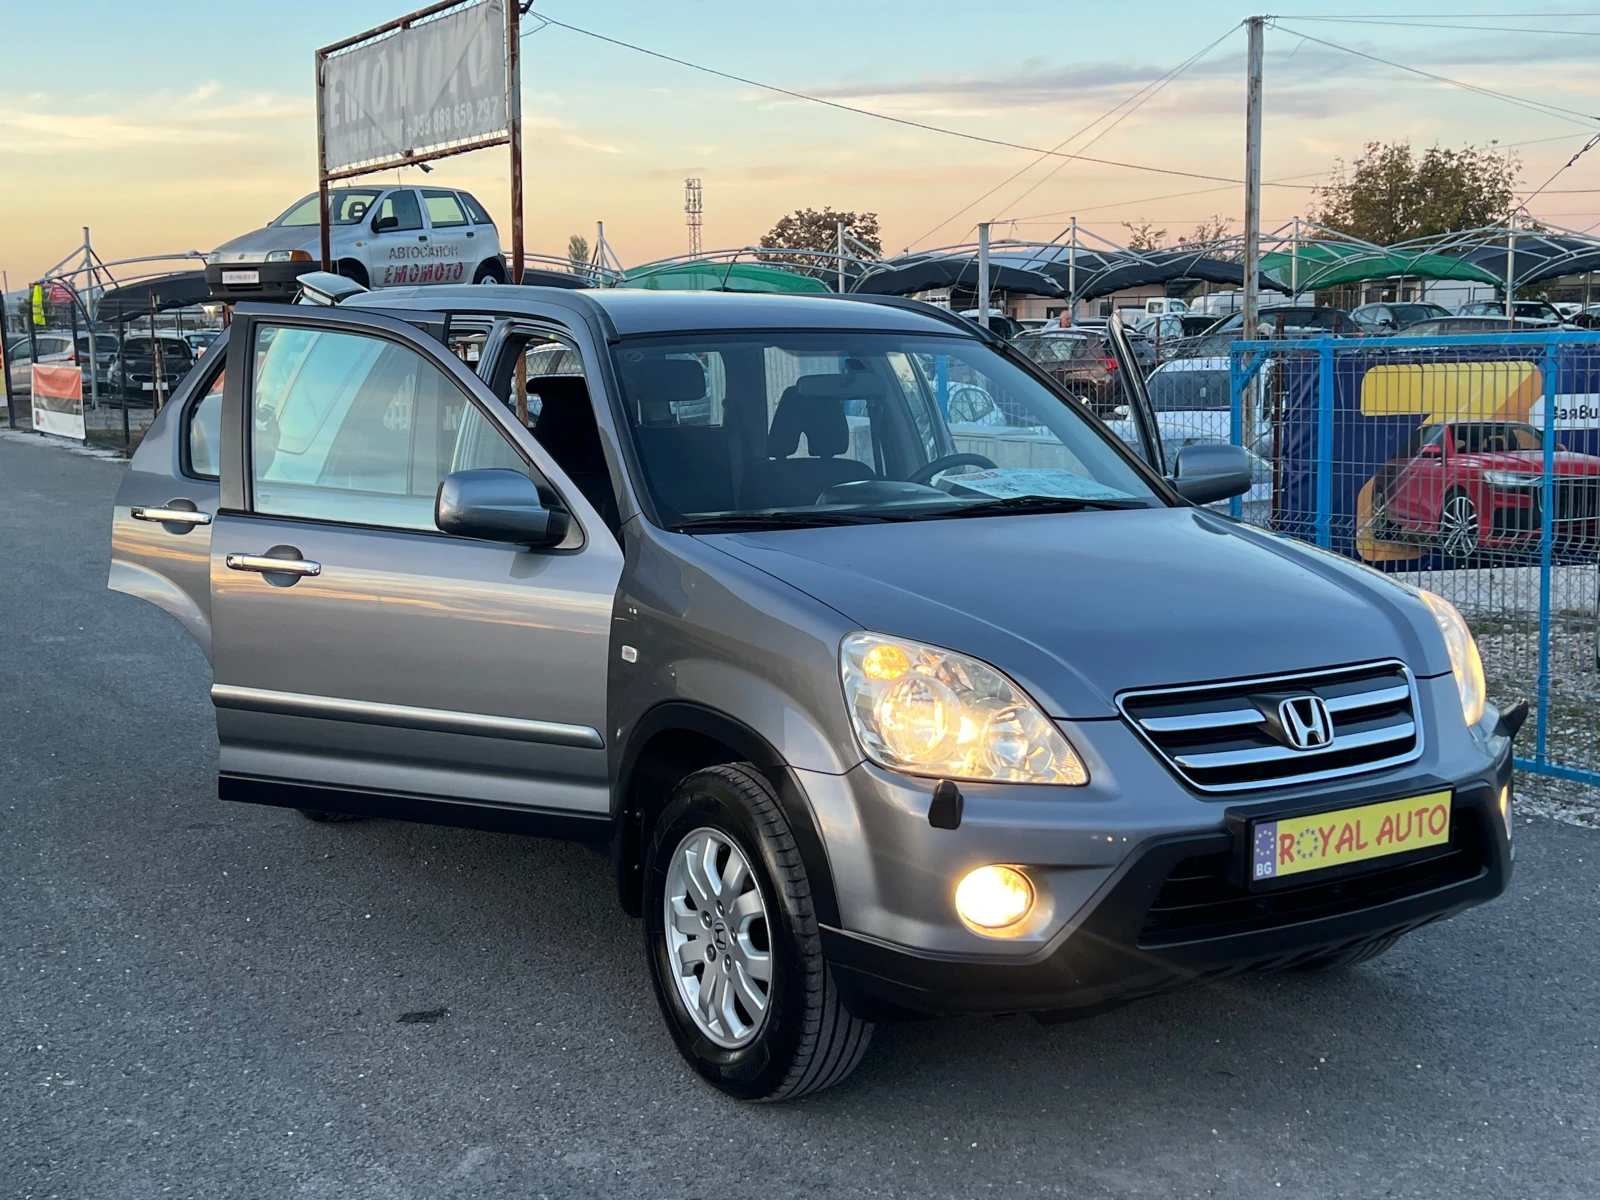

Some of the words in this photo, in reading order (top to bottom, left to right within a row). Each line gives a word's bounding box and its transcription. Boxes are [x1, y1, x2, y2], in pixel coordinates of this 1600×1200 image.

[1279, 820, 1368, 865] ROYAL
[1375, 804, 1448, 846] AUTO
[1256, 862, 1272, 877] BG
